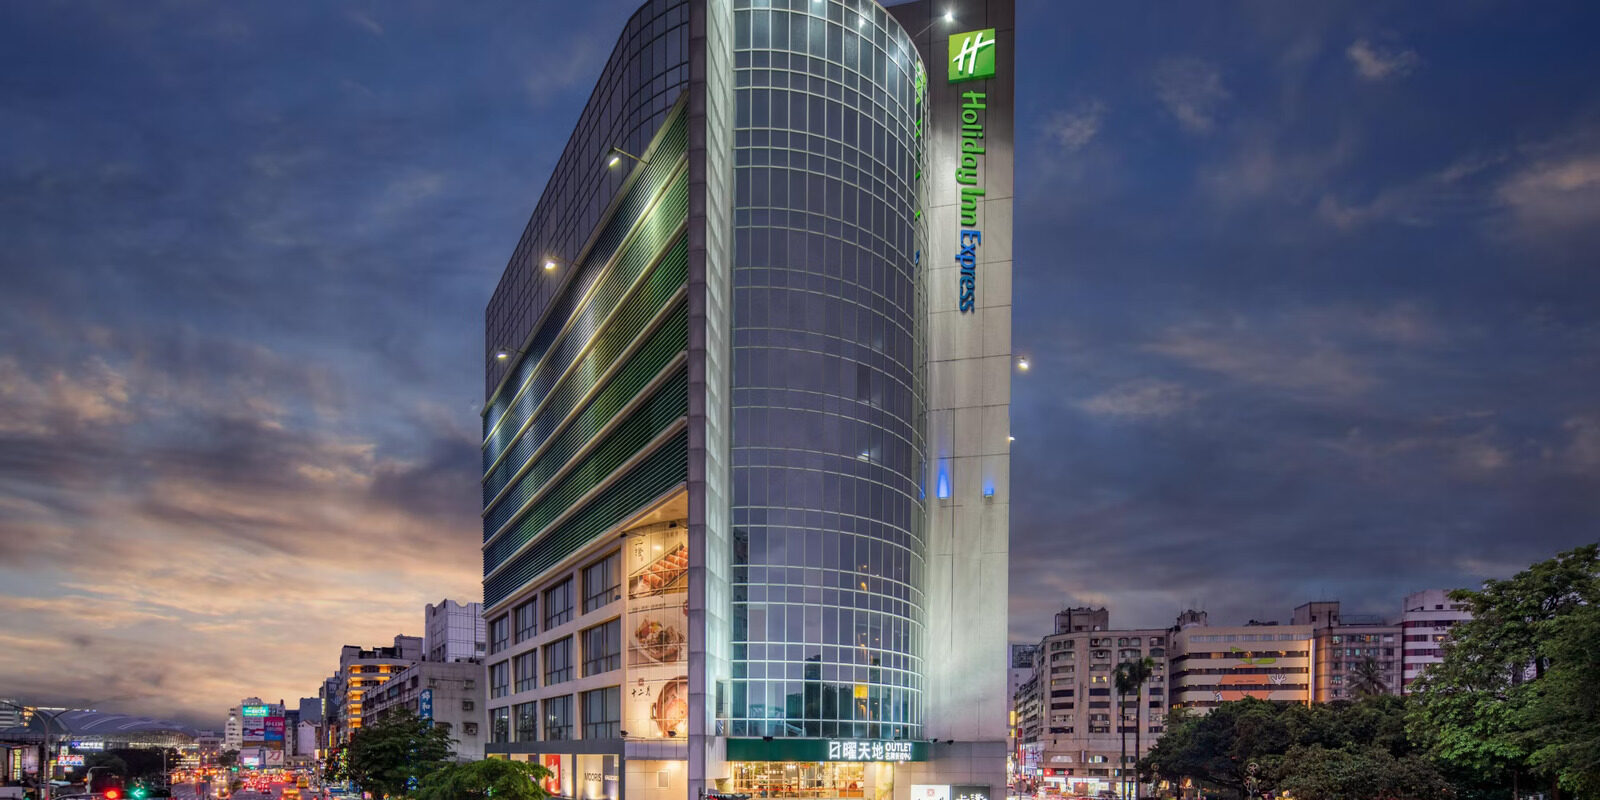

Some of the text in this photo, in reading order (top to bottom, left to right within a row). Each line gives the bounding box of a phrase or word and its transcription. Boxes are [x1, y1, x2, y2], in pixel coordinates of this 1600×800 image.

[955, 90, 986, 313] Holiday Inn Express
[829, 741, 884, 760] 日曜天地
[885, 742, 912, 752] OUTLET
